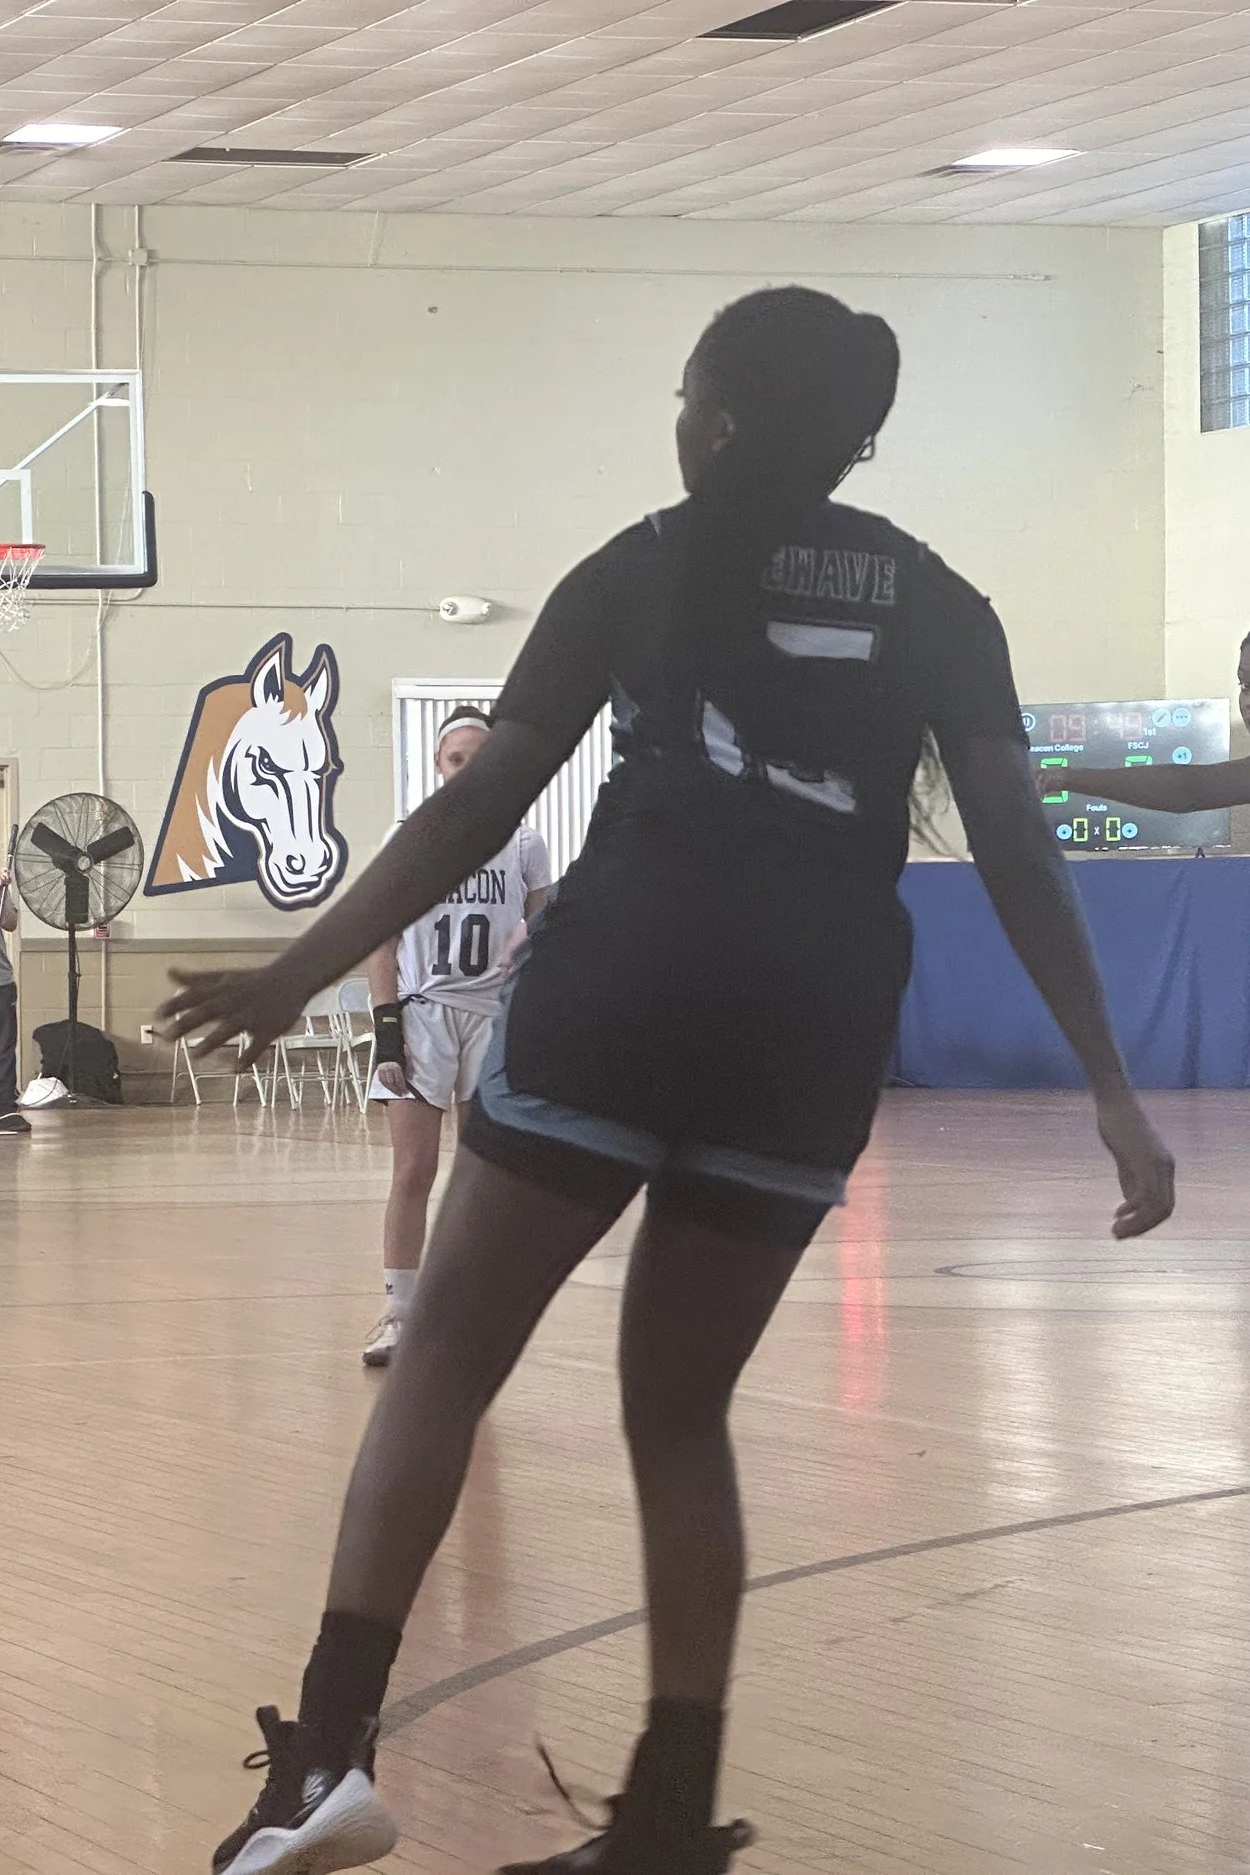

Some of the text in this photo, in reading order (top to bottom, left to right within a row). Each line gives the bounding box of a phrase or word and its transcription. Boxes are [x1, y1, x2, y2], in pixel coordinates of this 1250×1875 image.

[1142, 726, 1157, 737] 1st
[1054, 743, 1084, 752] College
[1128, 742, 1149, 750] FSCJ
[431, 914, 490, 976] 10
